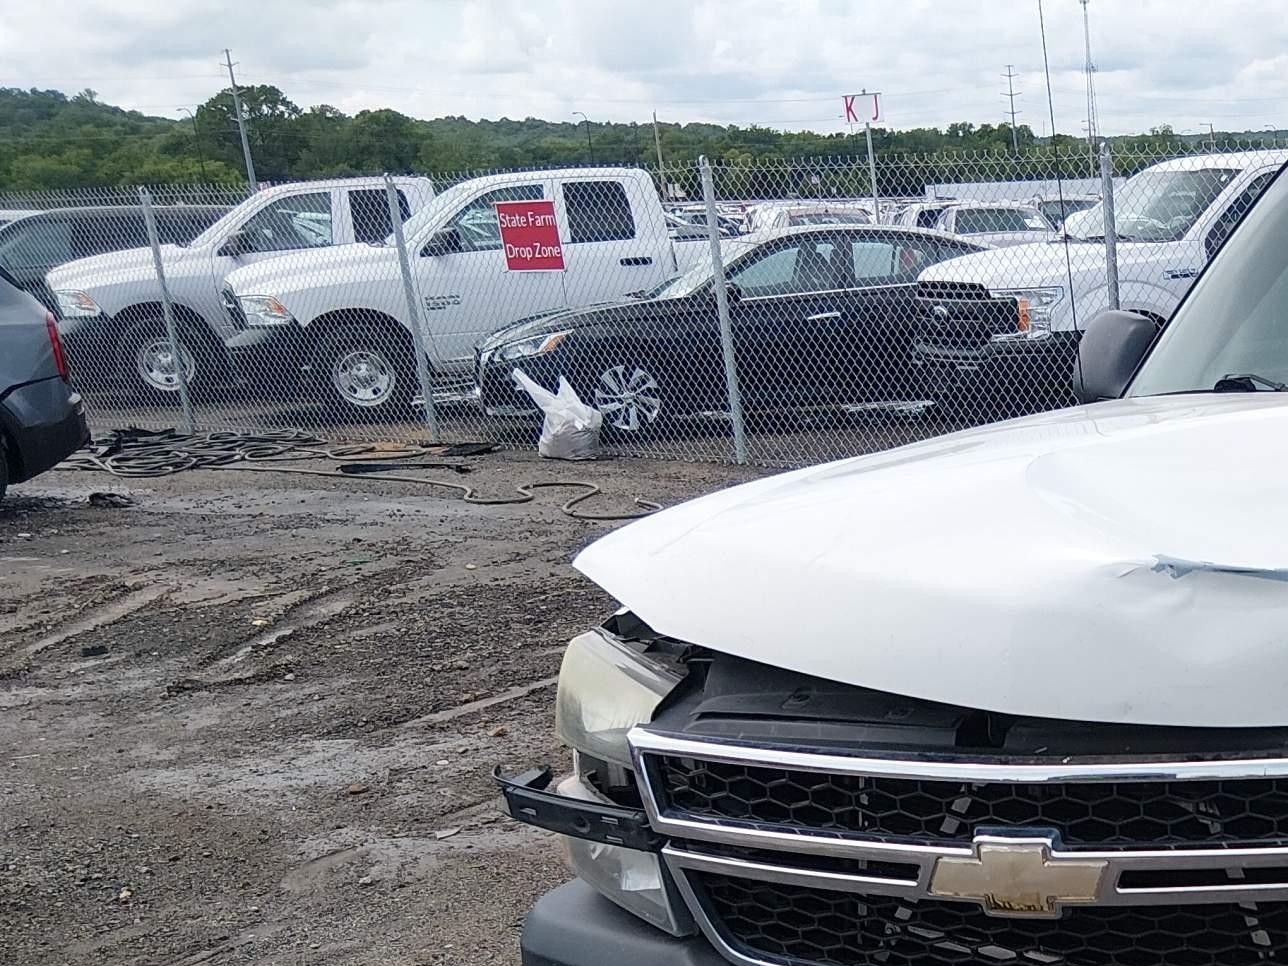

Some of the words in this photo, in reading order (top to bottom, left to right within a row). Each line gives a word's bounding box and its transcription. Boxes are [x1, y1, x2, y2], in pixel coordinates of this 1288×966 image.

[500, 213, 527, 228] State
[528, 212, 556, 227] Farm
[506, 244, 533, 261] Drop
[533, 243, 561, 258] Zone
